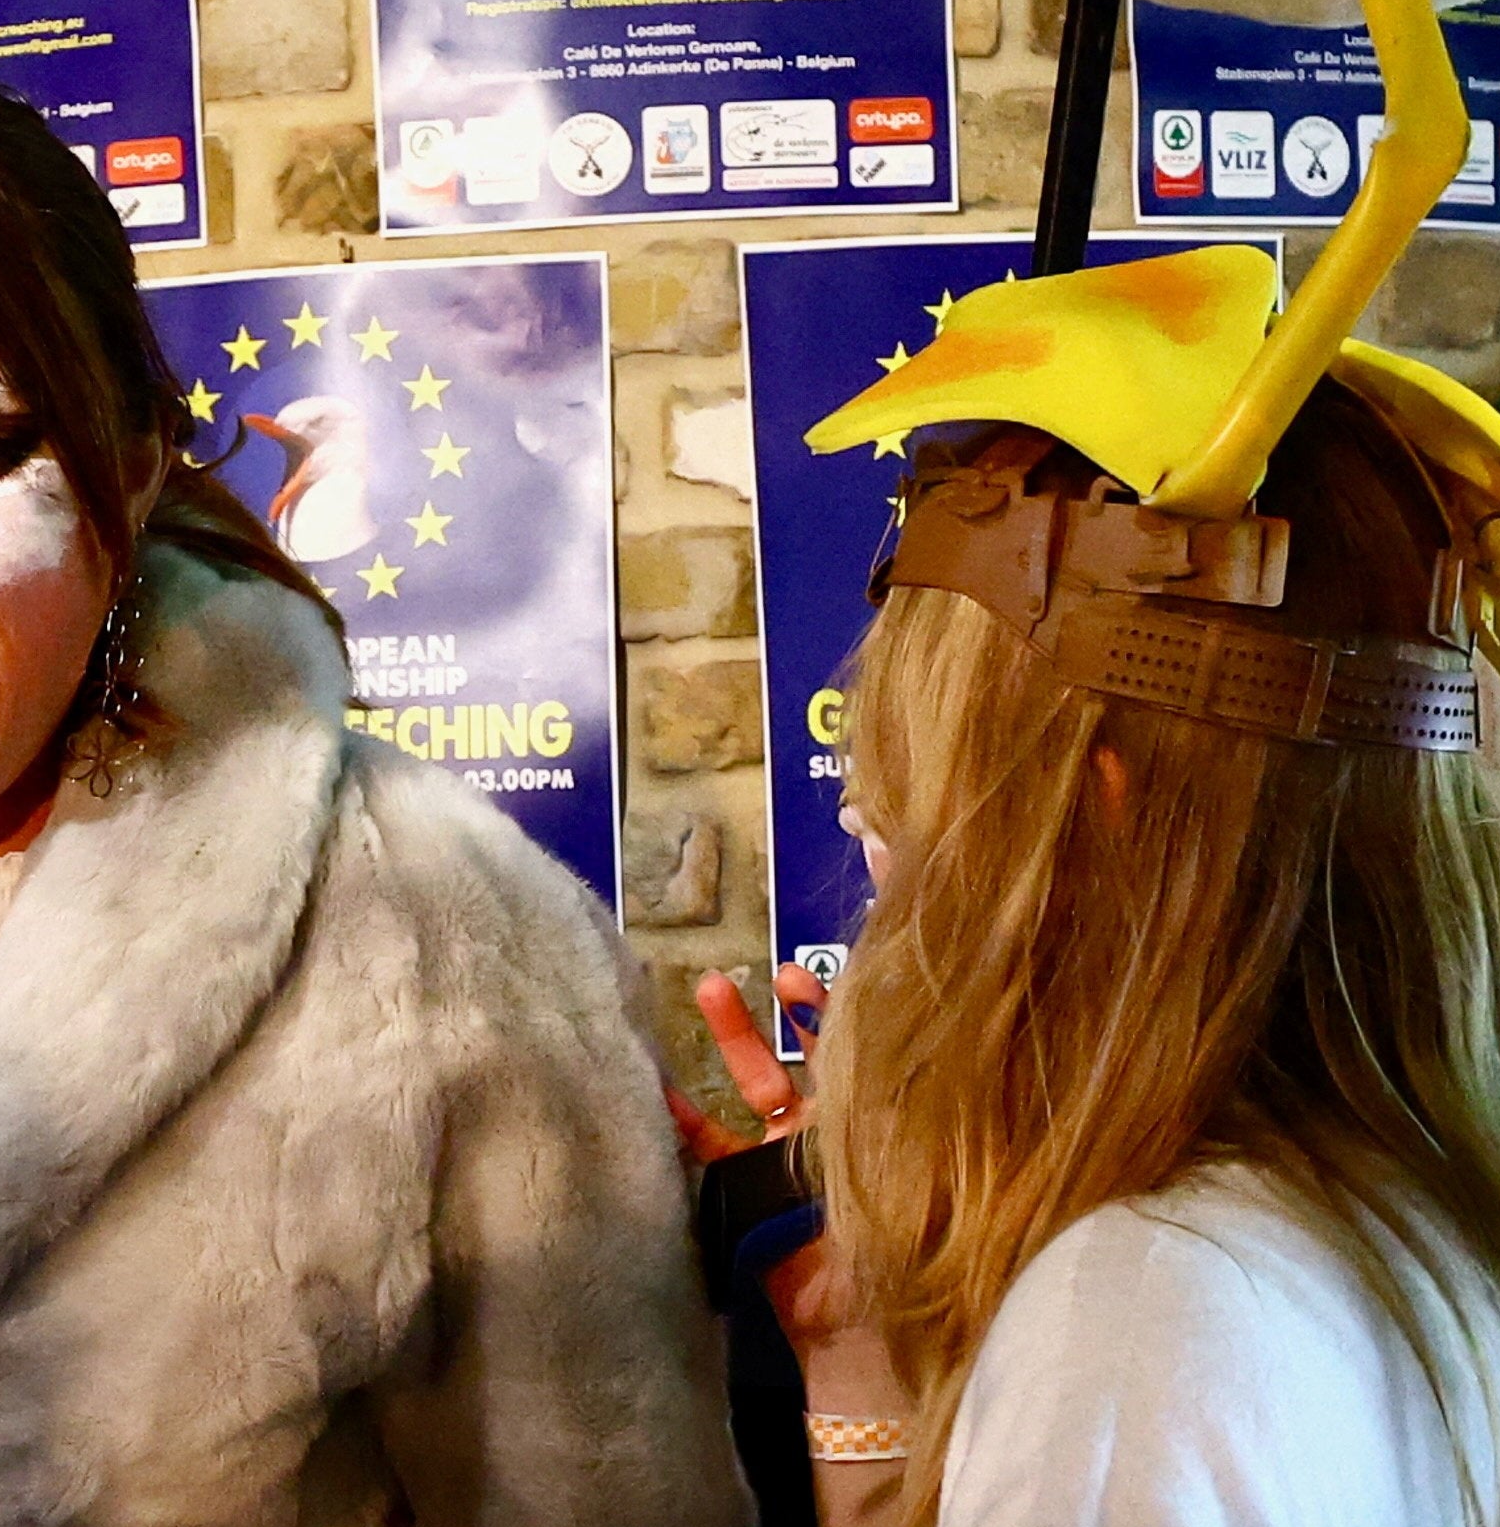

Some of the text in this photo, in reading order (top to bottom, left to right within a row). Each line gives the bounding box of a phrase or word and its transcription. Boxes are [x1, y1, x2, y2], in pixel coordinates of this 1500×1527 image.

[627, 23, 696, 38] Location:
[601, 46, 622, 59] De
[567, 65, 576, 79] 3
[796, 54, 855, 70] Belgium
[1218, 150, 1267, 169] VLIZ
